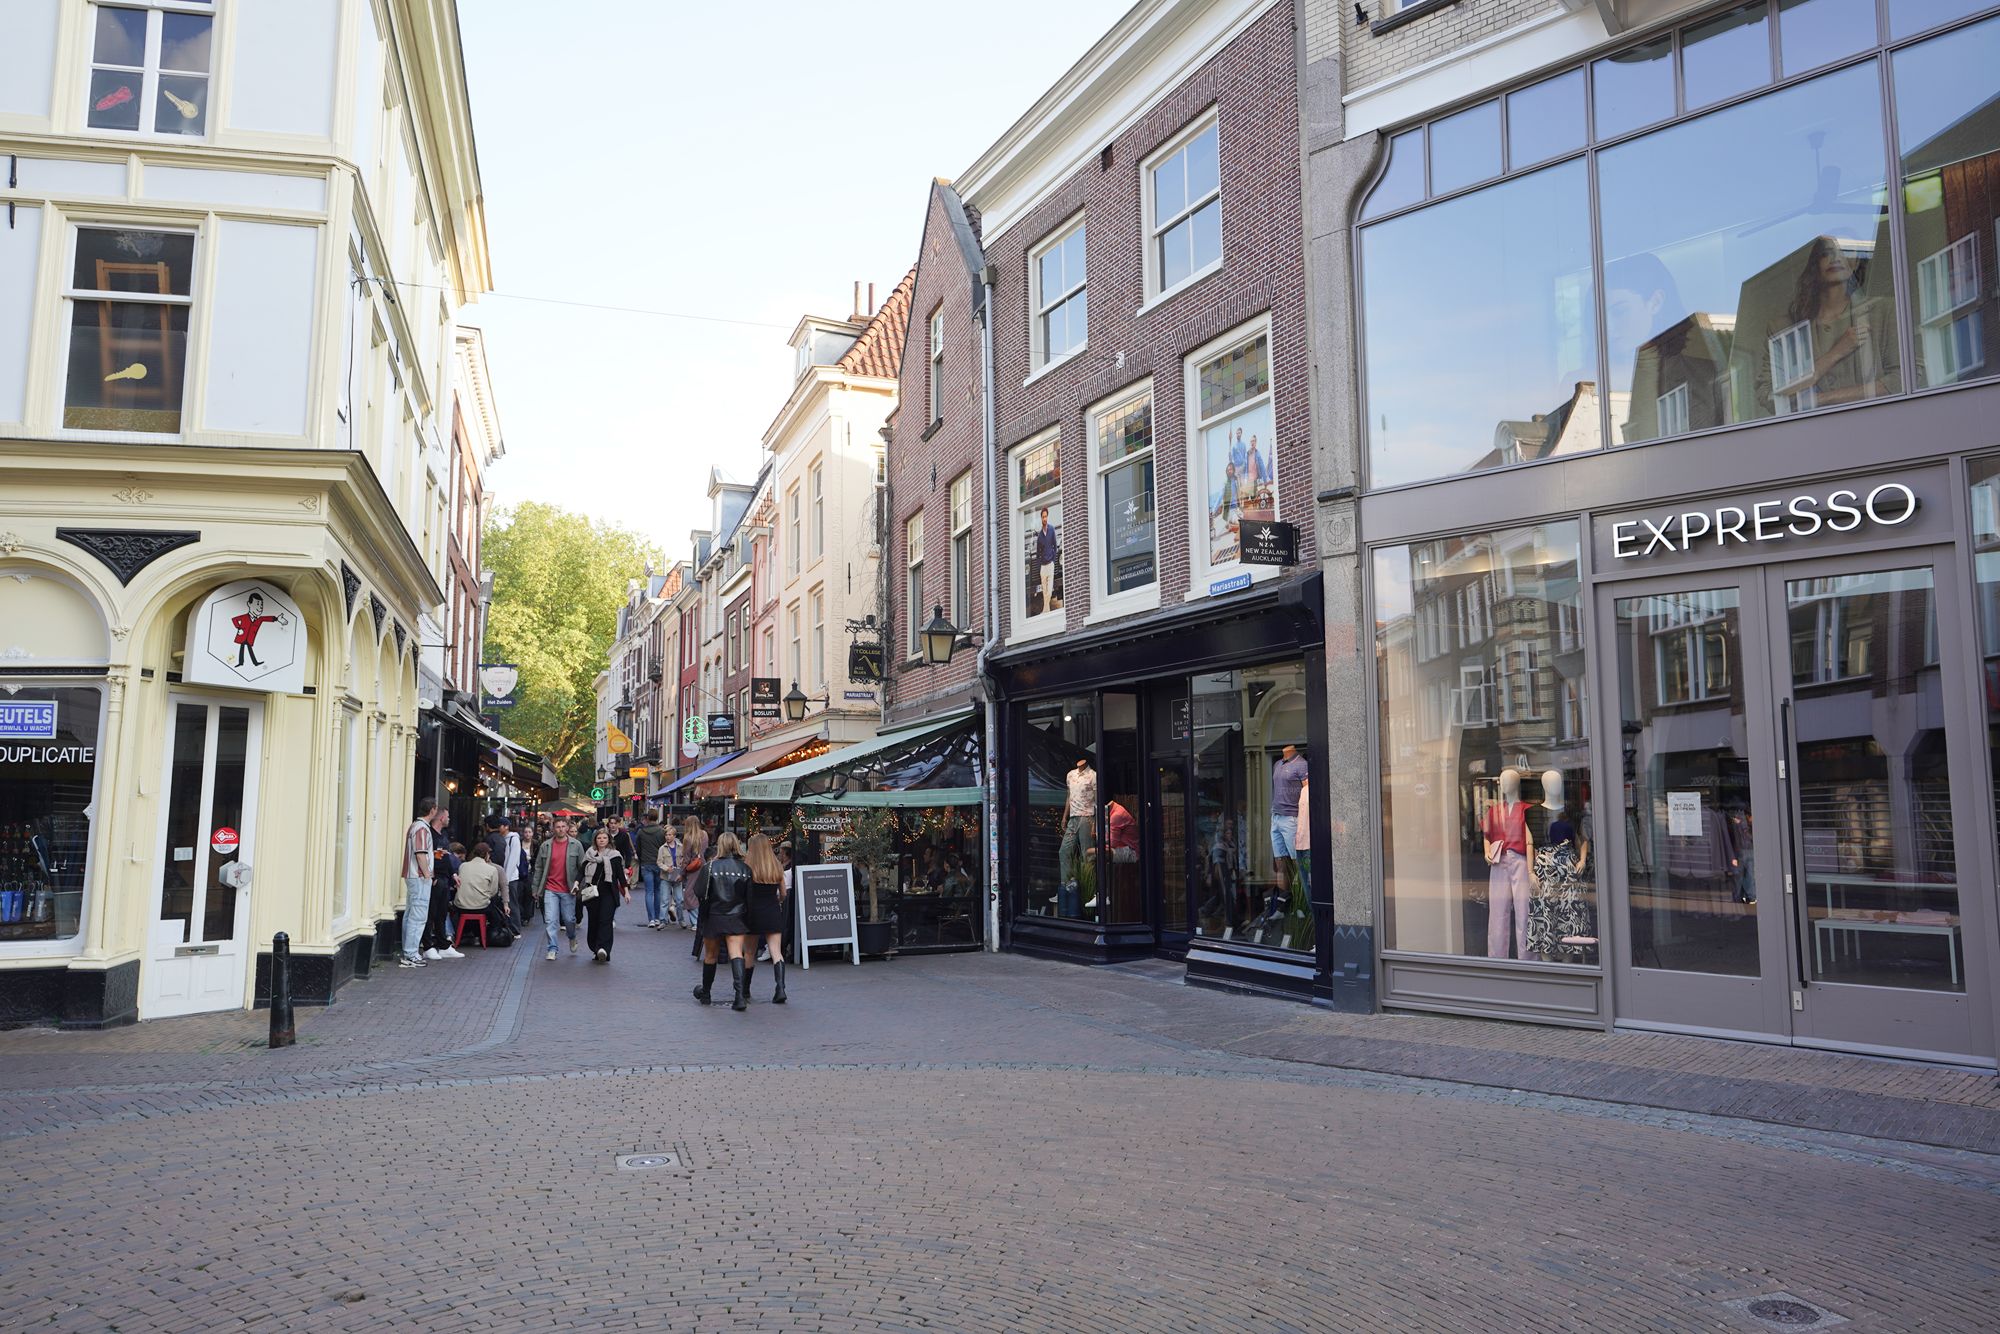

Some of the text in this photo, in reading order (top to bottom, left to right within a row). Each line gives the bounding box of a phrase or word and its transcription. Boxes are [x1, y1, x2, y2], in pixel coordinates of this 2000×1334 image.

[1612, 483, 1916, 558] EXPRESSO
[1211, 577, 1247, 593] Mariastraat
[813, 888, 839, 896] LUNCH
[815, 896, 839, 904] DINER
[815, 904, 840, 912] WINES
[807, 912, 849, 922] COCKTAILS
